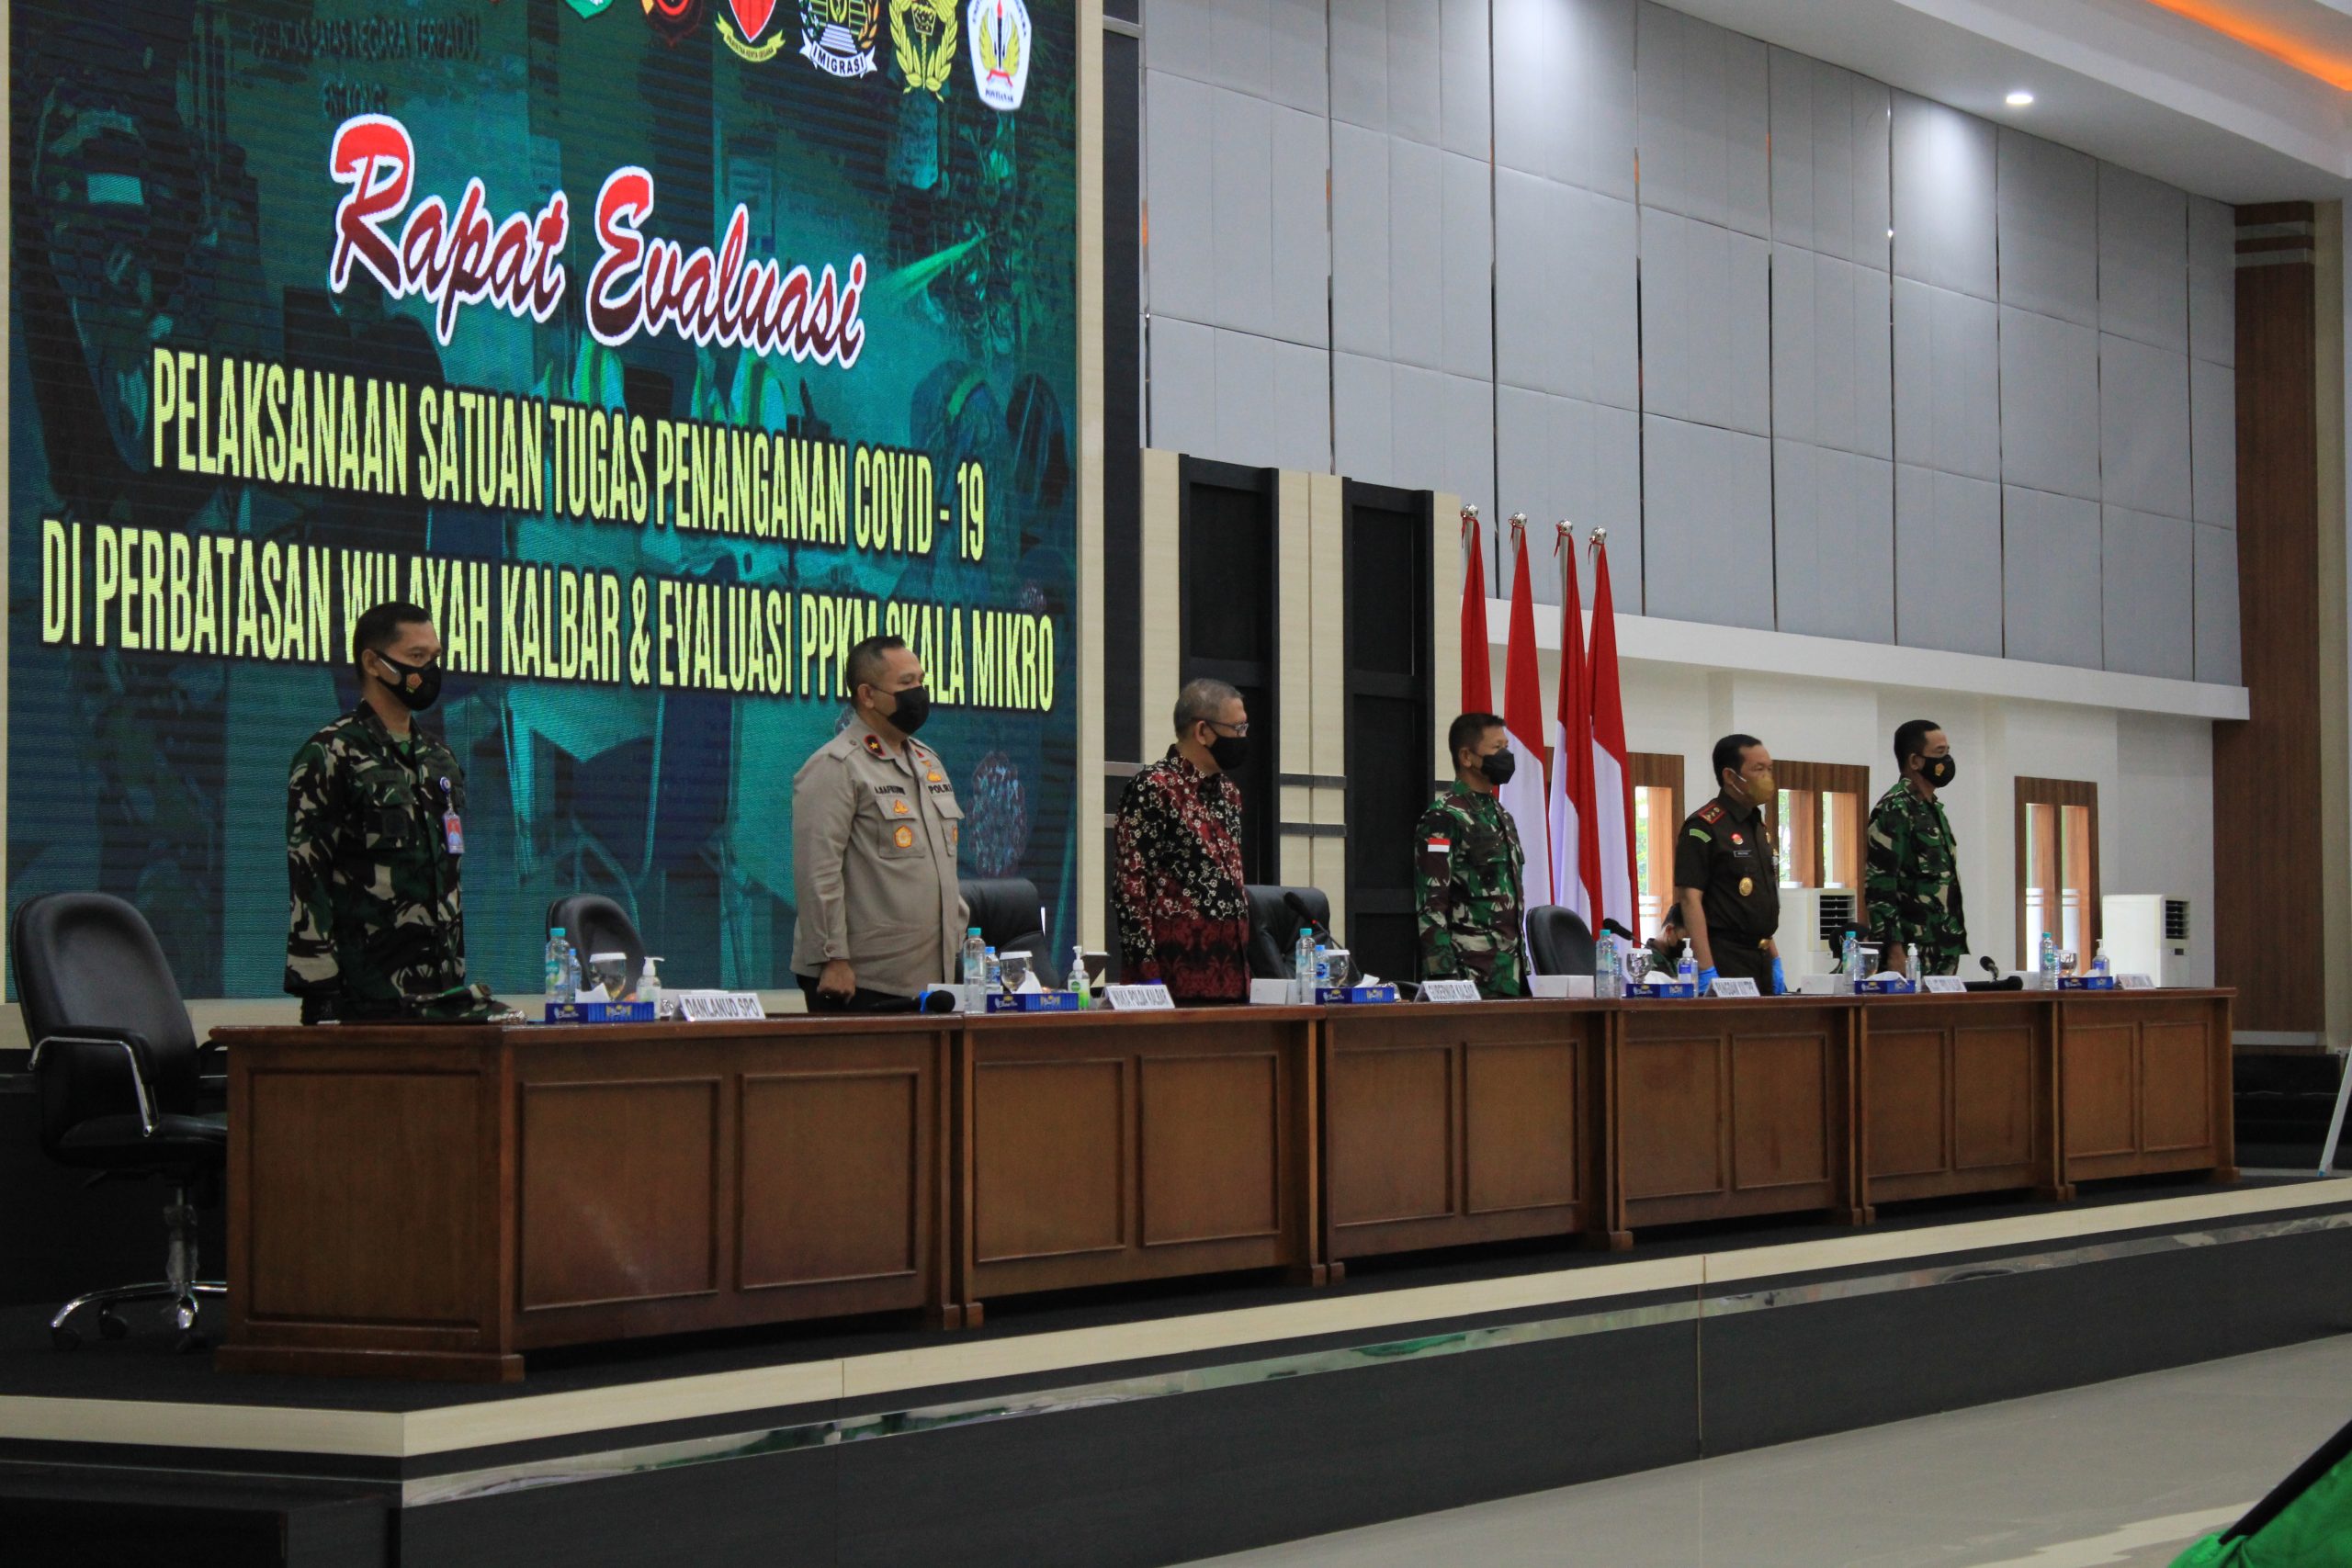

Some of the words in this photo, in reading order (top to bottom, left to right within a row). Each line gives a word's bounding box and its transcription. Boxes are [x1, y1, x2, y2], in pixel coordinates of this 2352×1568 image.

[812, 46, 865, 74] IMIGRASI
[330, 113, 569, 346] Rapat
[585, 166, 866, 369] Evaluasi
[153, 348, 407, 494] PELAKSANAAN
[419, 385, 542, 511] SATUAN
[549, 404, 647, 524] TUGAS
[656, 420, 846, 545] PENANGANAN
[854, 446, 933, 553] COVID
[43, 520, 81, 643] DI
[96, 525, 330, 661] PERBATASAN
[501, 565, 620, 682] KALBAR
[629, 577, 650, 684] &
[659, 581, 792, 694] EVALUASI
[972, 610, 1054, 711] MIKRO
[927, 784, 953, 795] POLRI
[684, 998, 739, 1018] DANLANUD
[738, 998, 761, 1017] SPO
